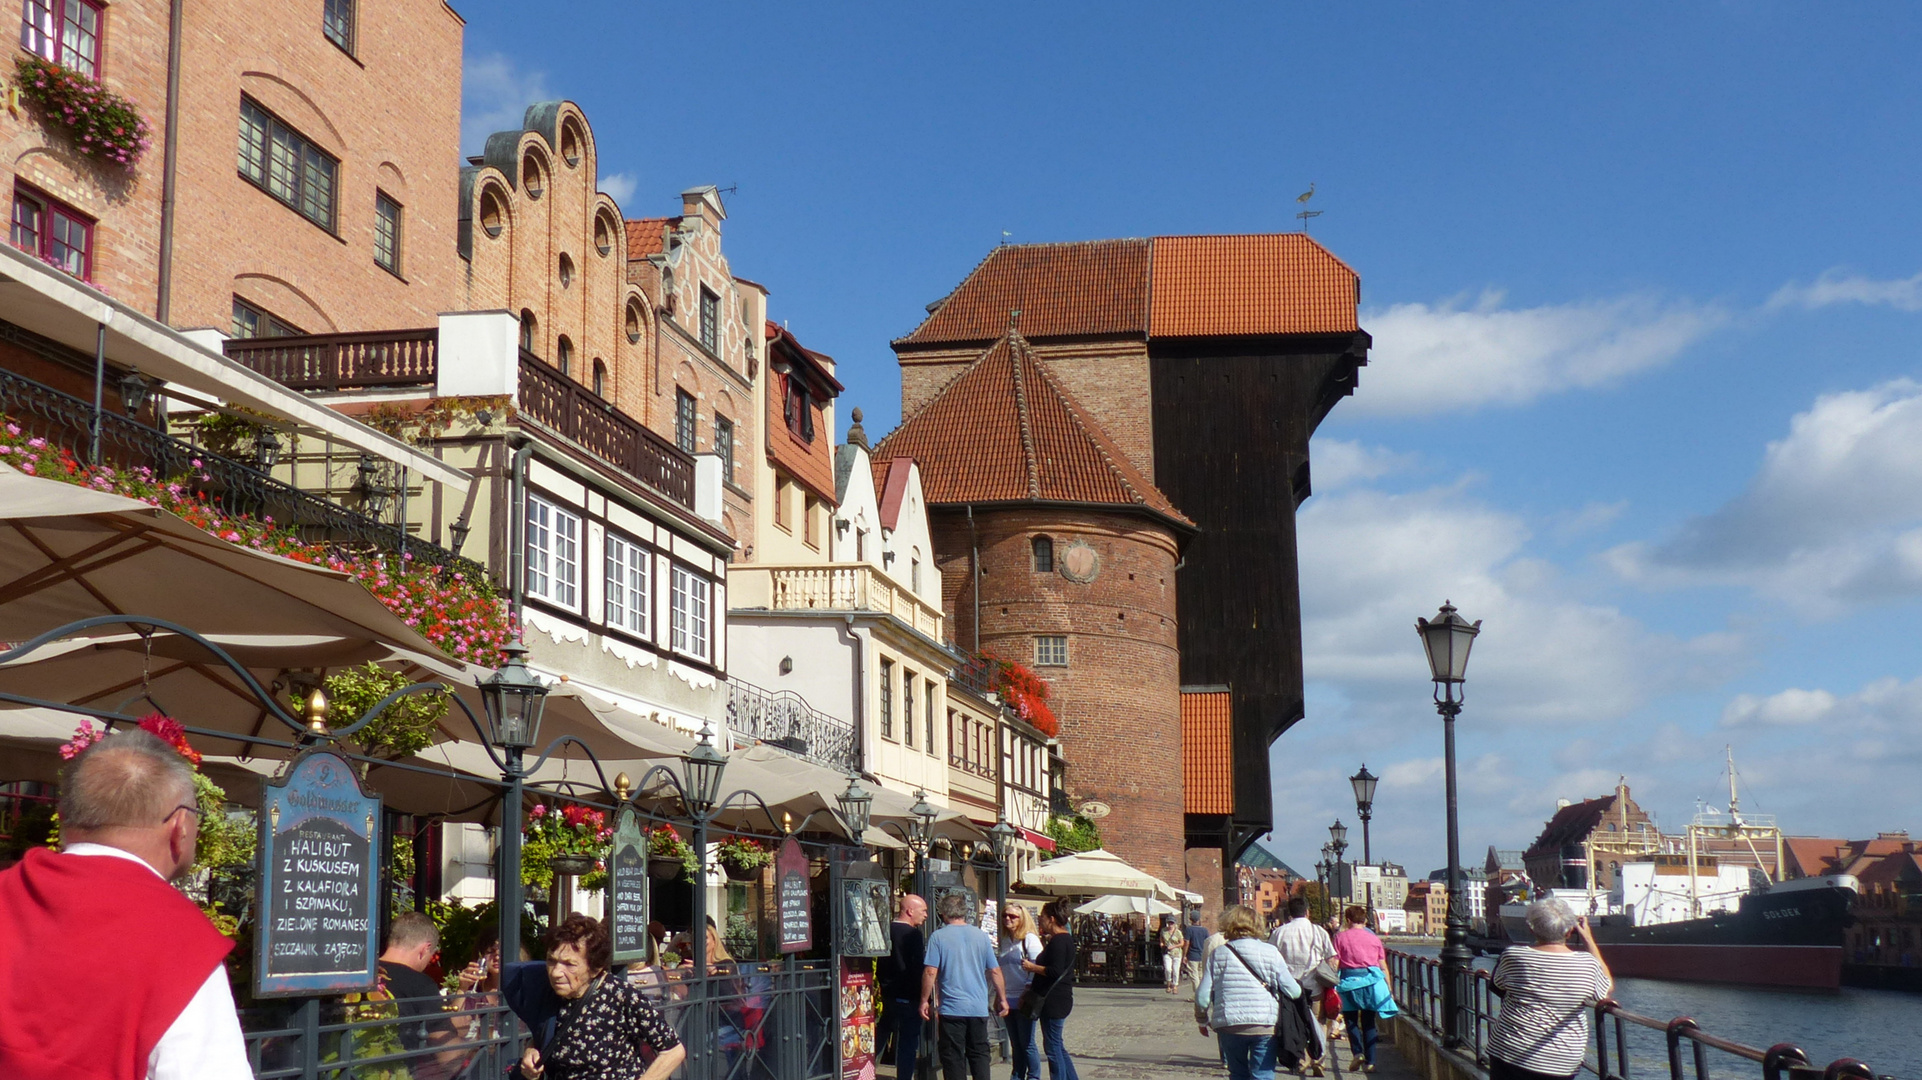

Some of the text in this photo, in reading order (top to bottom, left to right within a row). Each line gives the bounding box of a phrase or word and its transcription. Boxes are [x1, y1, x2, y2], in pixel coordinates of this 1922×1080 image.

[291, 839, 352, 857] HALIBUT
[283, 858, 360, 878] Z KUSKUSEM
[283, 879, 358, 897] Z KALAFIORA
[295, 896, 353, 916] SZPINAKU,
[276, 916, 318, 931] ZIELONE
[274, 942, 319, 957] SZCZAWIK
